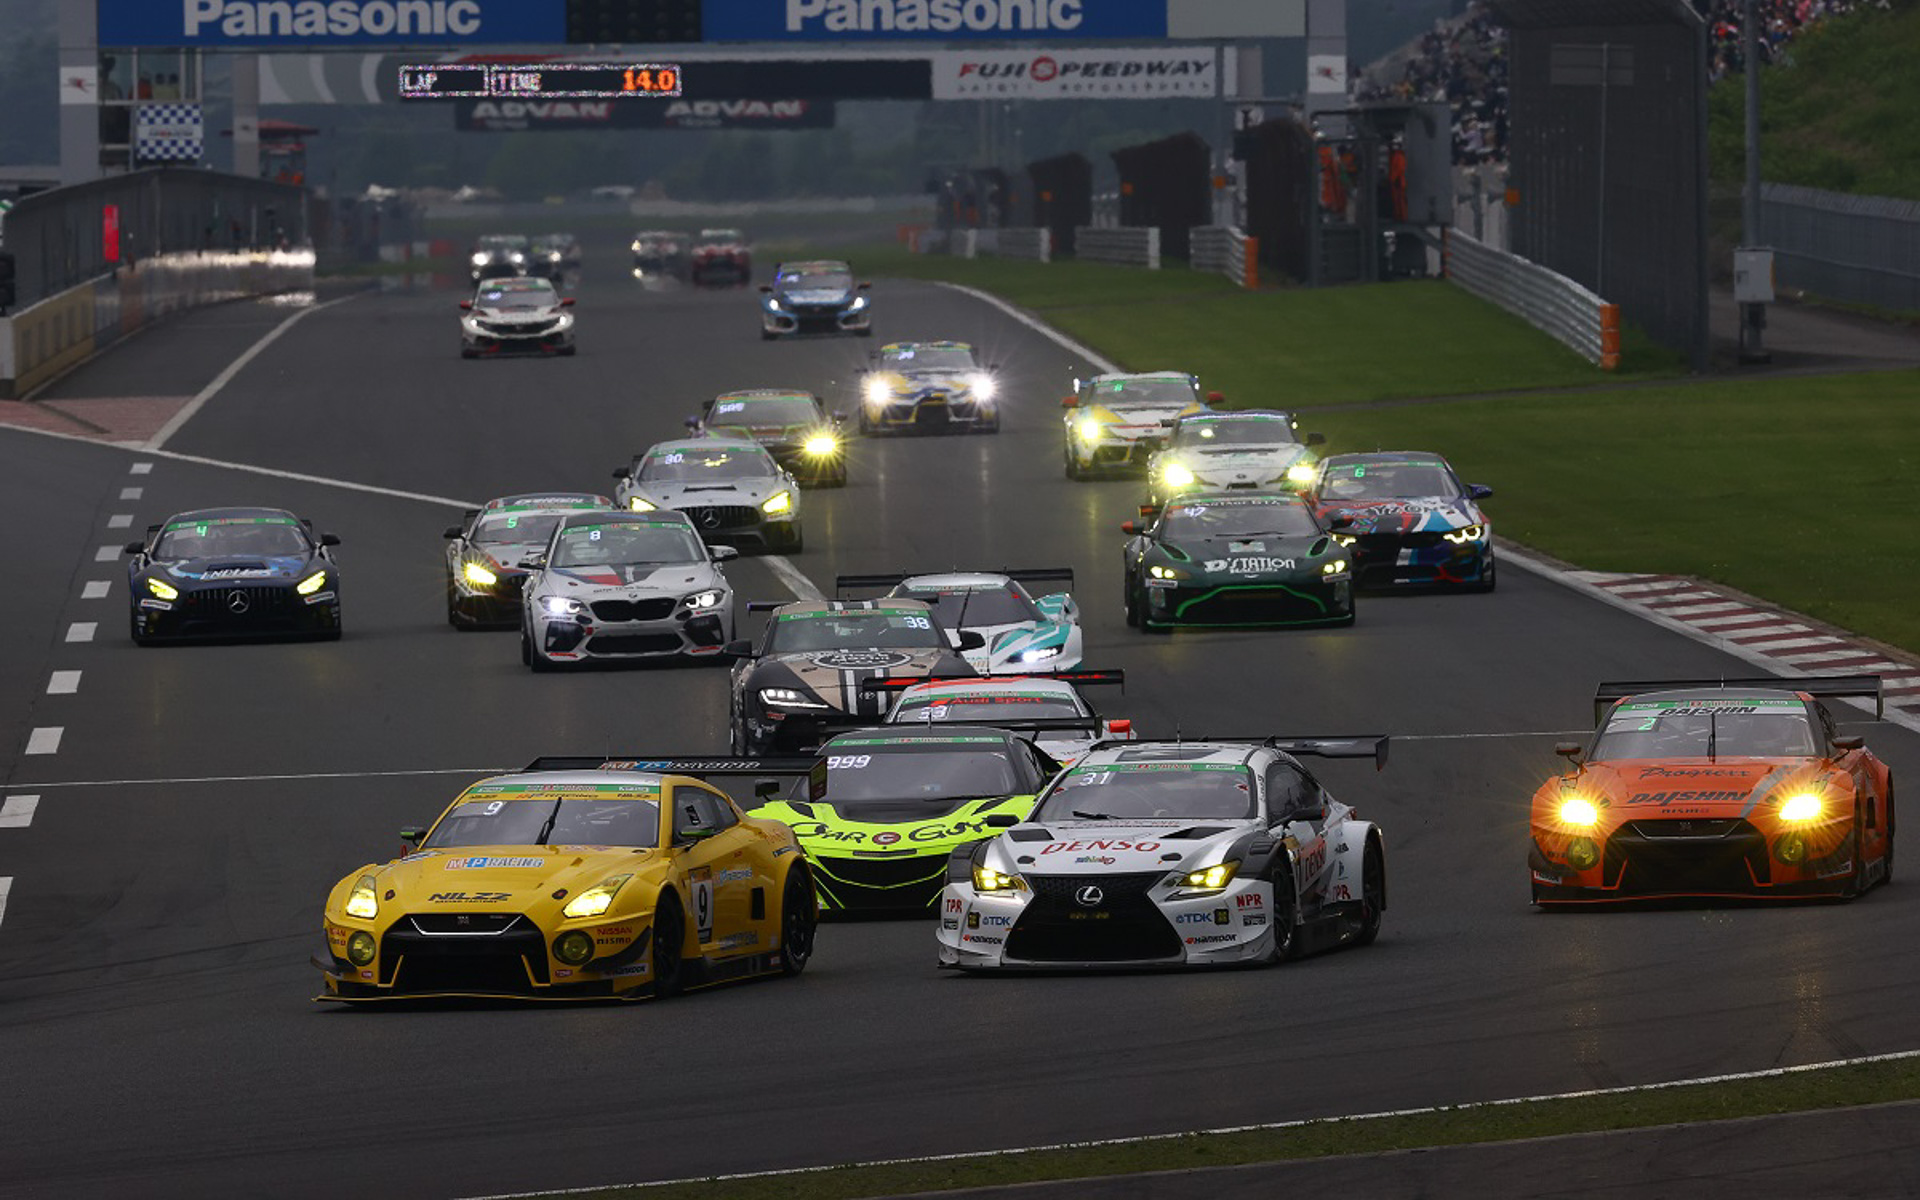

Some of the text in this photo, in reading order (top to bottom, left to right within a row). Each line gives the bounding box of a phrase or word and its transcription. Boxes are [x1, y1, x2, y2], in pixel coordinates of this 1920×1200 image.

[184, 0, 481, 36] Panasonic
[786, 0, 1084, 32] Panasonic
[959, 62, 1027, 78] FUJI
[404, 73, 438, 91] LAP
[497, 73, 542, 91] TIME
[622, 70, 677, 91] 14.0
[472, 102, 612, 118] ADVAN
[664, 100, 804, 117] ADVAN
[1354, 468, 1364, 478] 6
[507, 517, 517, 528] 5
[197, 526, 207, 536] 4
[590, 530, 601, 541] 8
[903, 616, 931, 630] 38
[1637, 717, 1656, 731] 2
[826, 754, 872, 769] 999
[1079, 771, 1111, 786] 31
[1627, 791, 1752, 806] DAISHIN
[483, 800, 504, 816] 9
[1040, 840, 1161, 855] DENSO
[698, 884, 708, 928] 9
[946, 899, 963, 913] TPR
[988, 916, 1012, 926] TDK
[1184, 912, 1212, 923] TDK
